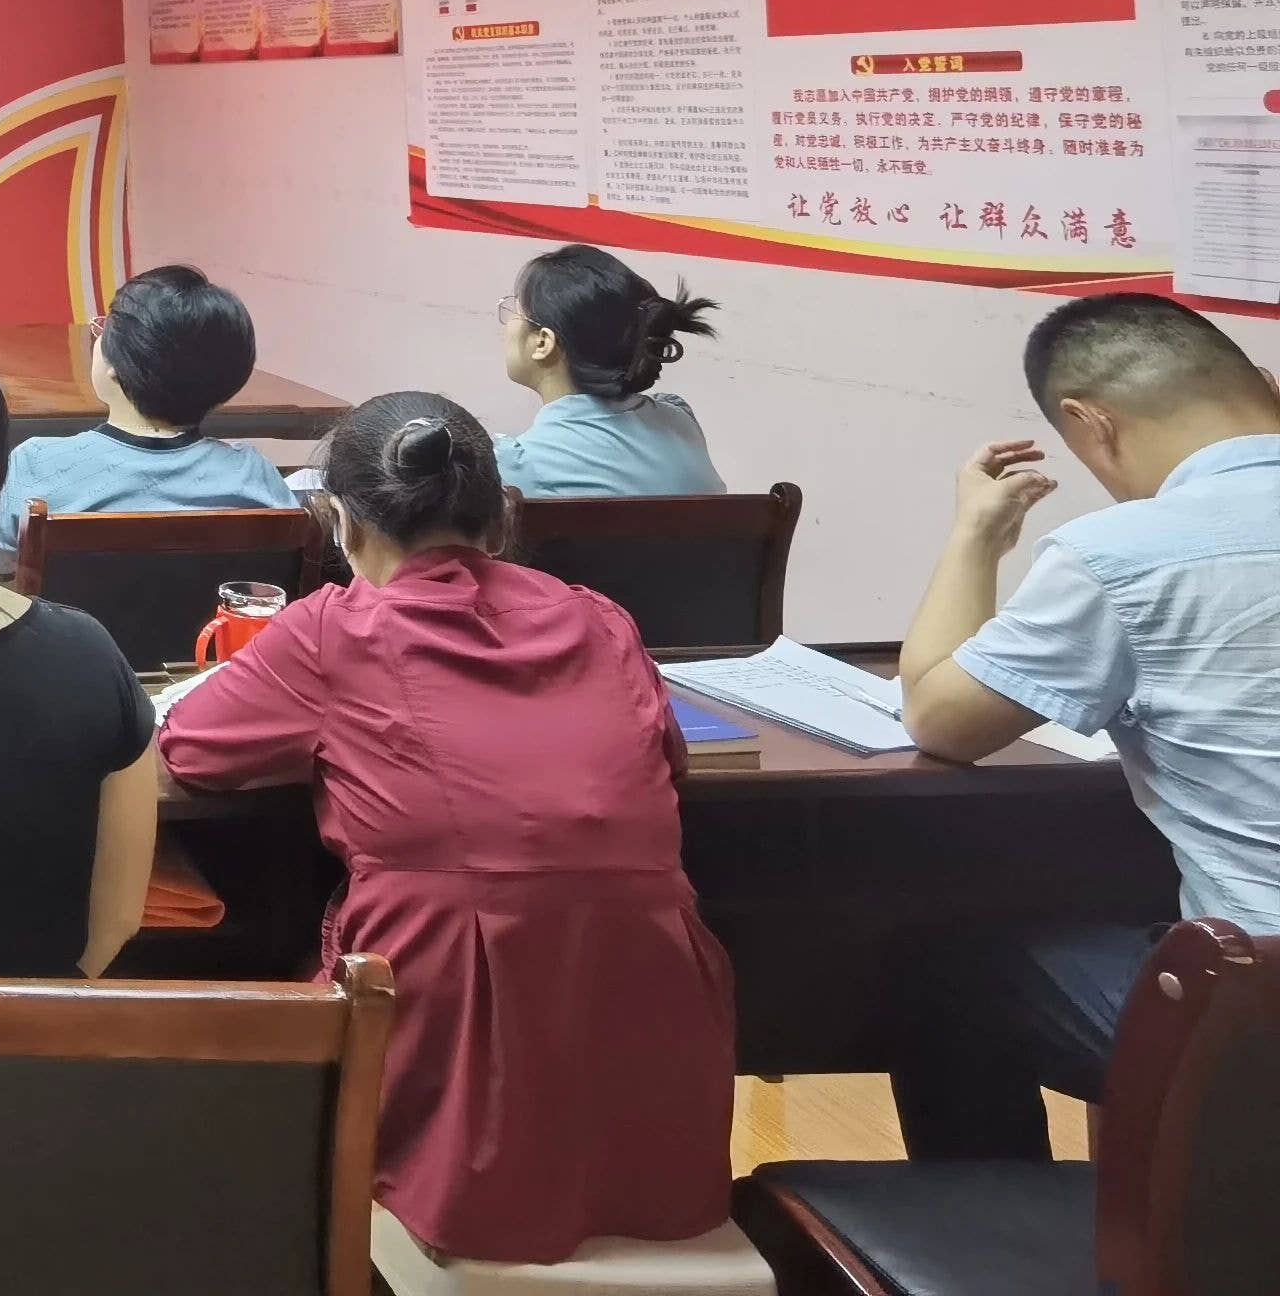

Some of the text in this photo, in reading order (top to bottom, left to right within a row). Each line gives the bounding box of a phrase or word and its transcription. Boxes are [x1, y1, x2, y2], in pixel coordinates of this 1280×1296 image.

[903, 55, 963, 73] 入党誓词
[787, 191, 911, 225] 让党放心
[939, 201, 1137, 249] 让群众满意
